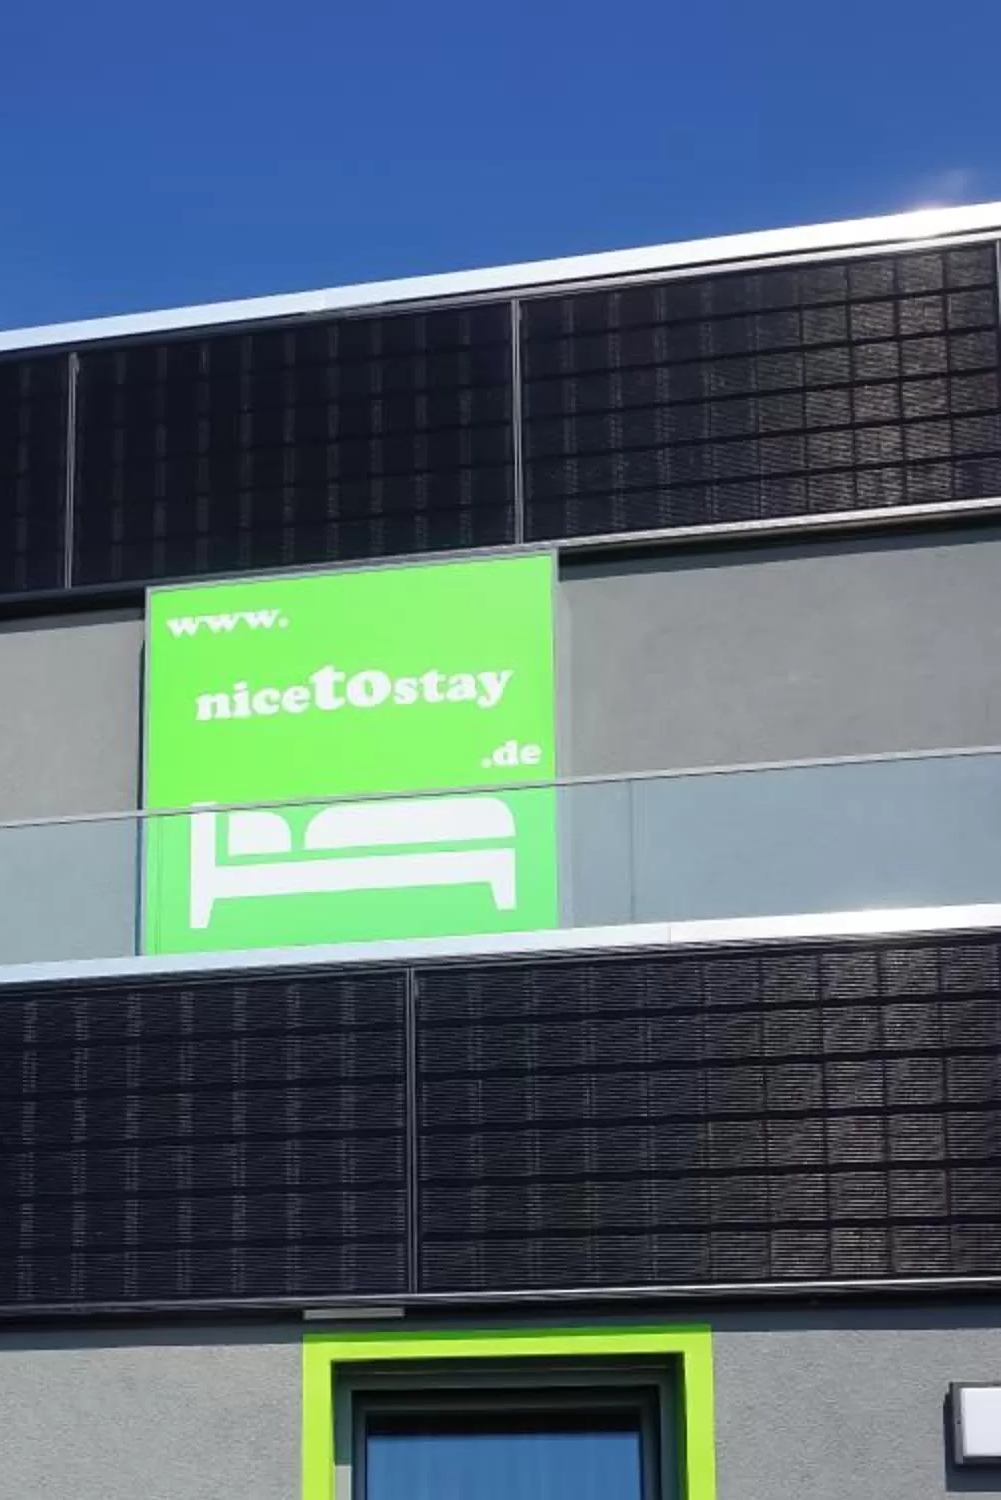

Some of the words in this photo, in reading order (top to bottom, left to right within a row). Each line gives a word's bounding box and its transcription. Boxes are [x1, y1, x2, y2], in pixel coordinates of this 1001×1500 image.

[166, 608, 289, 638] www.
[194, 664, 514, 722] nicetostay
[480, 739, 543, 769] .de
